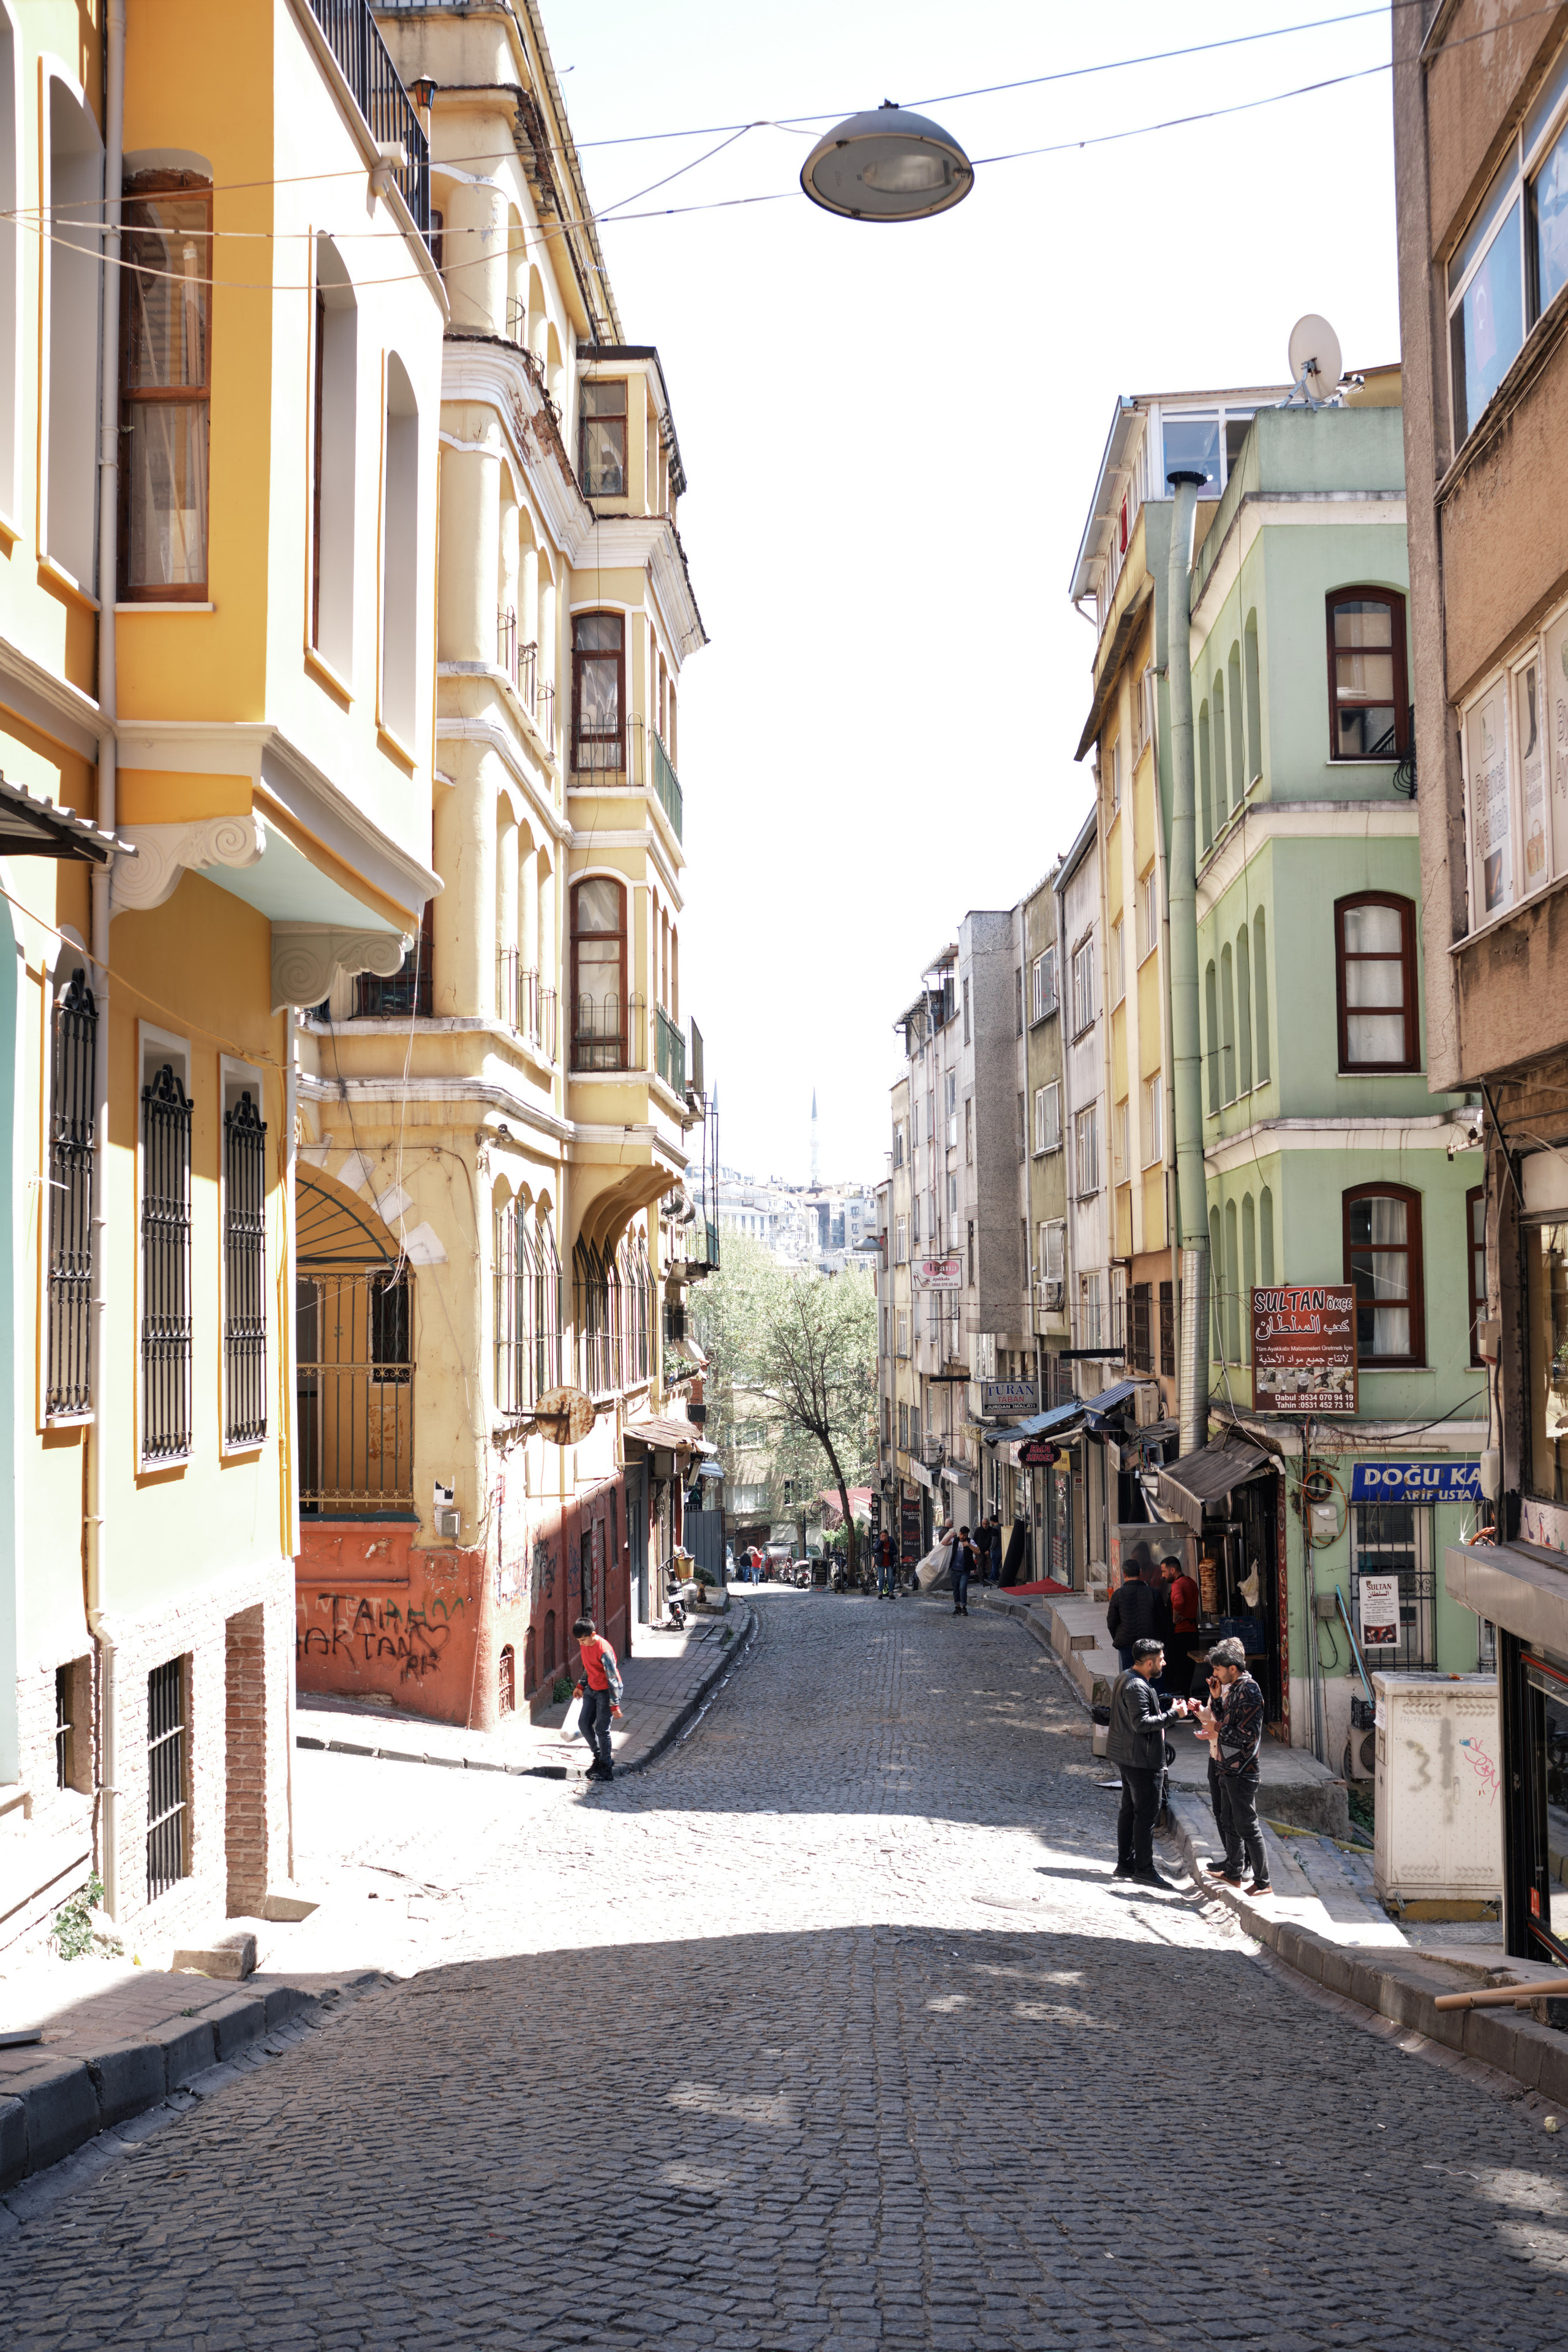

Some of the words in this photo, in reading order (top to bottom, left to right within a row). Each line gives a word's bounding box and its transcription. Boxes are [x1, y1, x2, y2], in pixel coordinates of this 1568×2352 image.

[927, 1262, 957, 1272] Tuana
[1254, 1290, 1325, 1313] SULTAN
[1326, 1295, 1352, 1313] ÖKÇE
[1256, 1314, 1321, 1340] السلطان
[1324, 1319, 1350, 1335] كعب
[1259, 1353, 1285, 1365] الأحذية
[1287, 1354, 1304, 1365] مواد
[1305, 1355, 1325, 1366] جميع
[1327, 1354, 1349, 1366] لإنتاج
[986, 1384, 1034, 1397] TURAN
[1026, 1453, 1054, 1462] SHOES
[1363, 1464, 1441, 1485] DOĞU
[1401, 1488, 1434, 1500] ARİF
[1438, 1489, 1472, 1500] USTA
